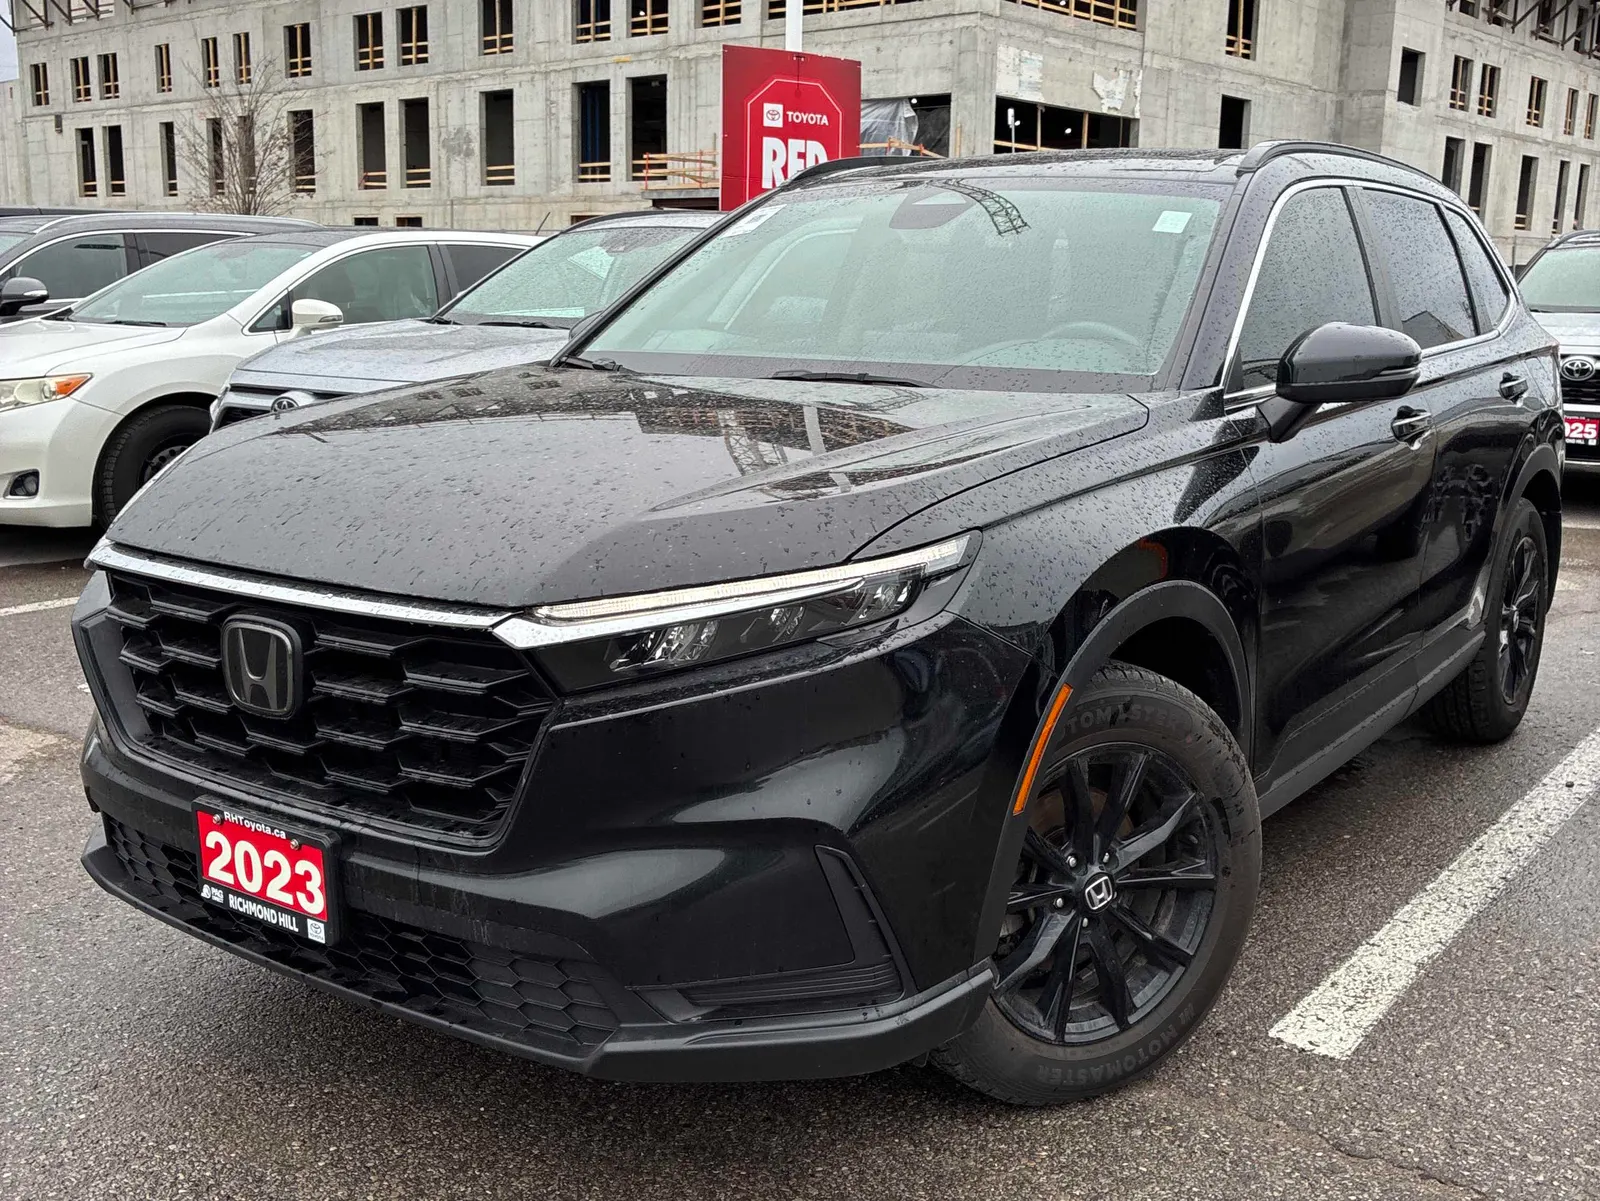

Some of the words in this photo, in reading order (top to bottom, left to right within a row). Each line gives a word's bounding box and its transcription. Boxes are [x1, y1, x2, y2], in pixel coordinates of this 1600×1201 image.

[786, 111, 829, 126] TOYOTA
[223, 811, 287, 840] RHToyota.ca
[205, 830, 325, 915] 2023
[228, 893, 277, 925] RICHMOND
[278, 911, 299, 933] HILL
